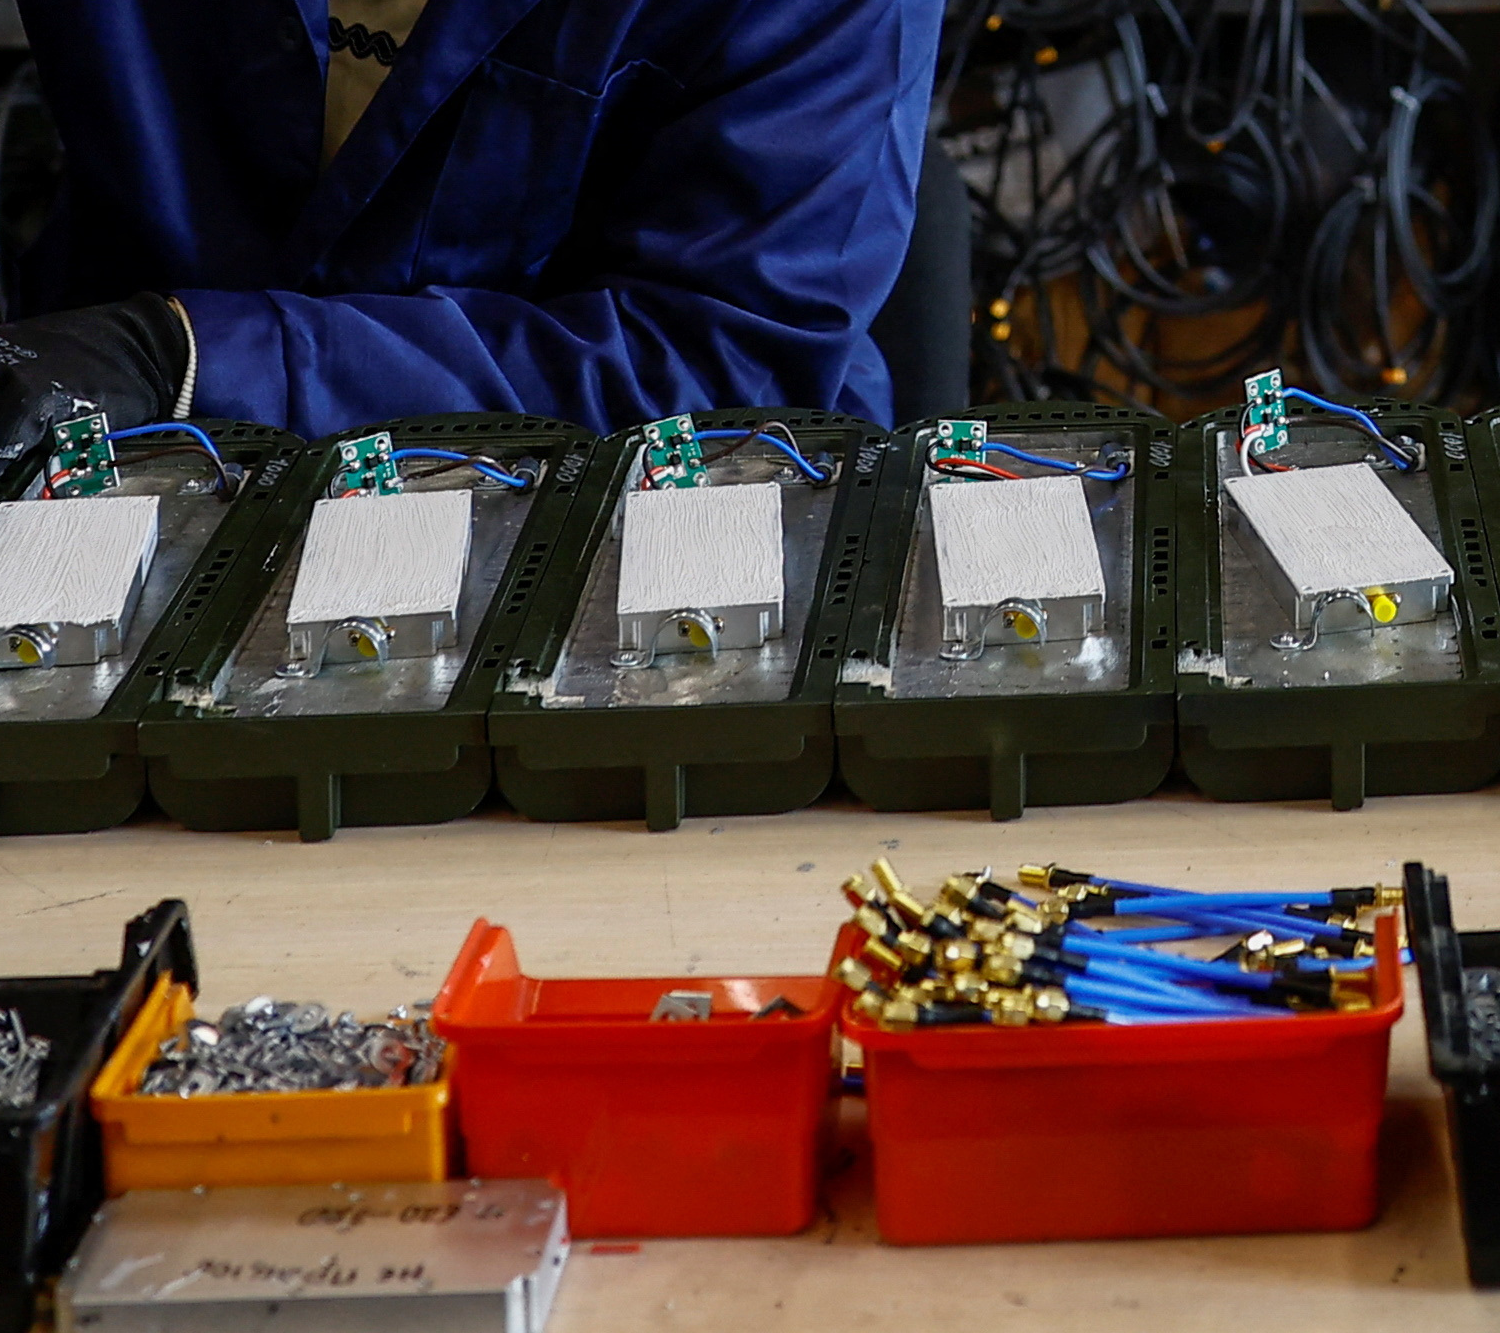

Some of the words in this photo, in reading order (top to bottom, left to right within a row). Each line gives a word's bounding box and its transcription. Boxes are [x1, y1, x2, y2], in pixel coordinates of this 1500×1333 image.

[853, 445, 883, 474] 1000
[1149, 440, 1173, 468] 1000
[1438, 431, 1467, 461] 1000
[257, 457, 290, 487] 1000
[555, 452, 587, 482] 1000
